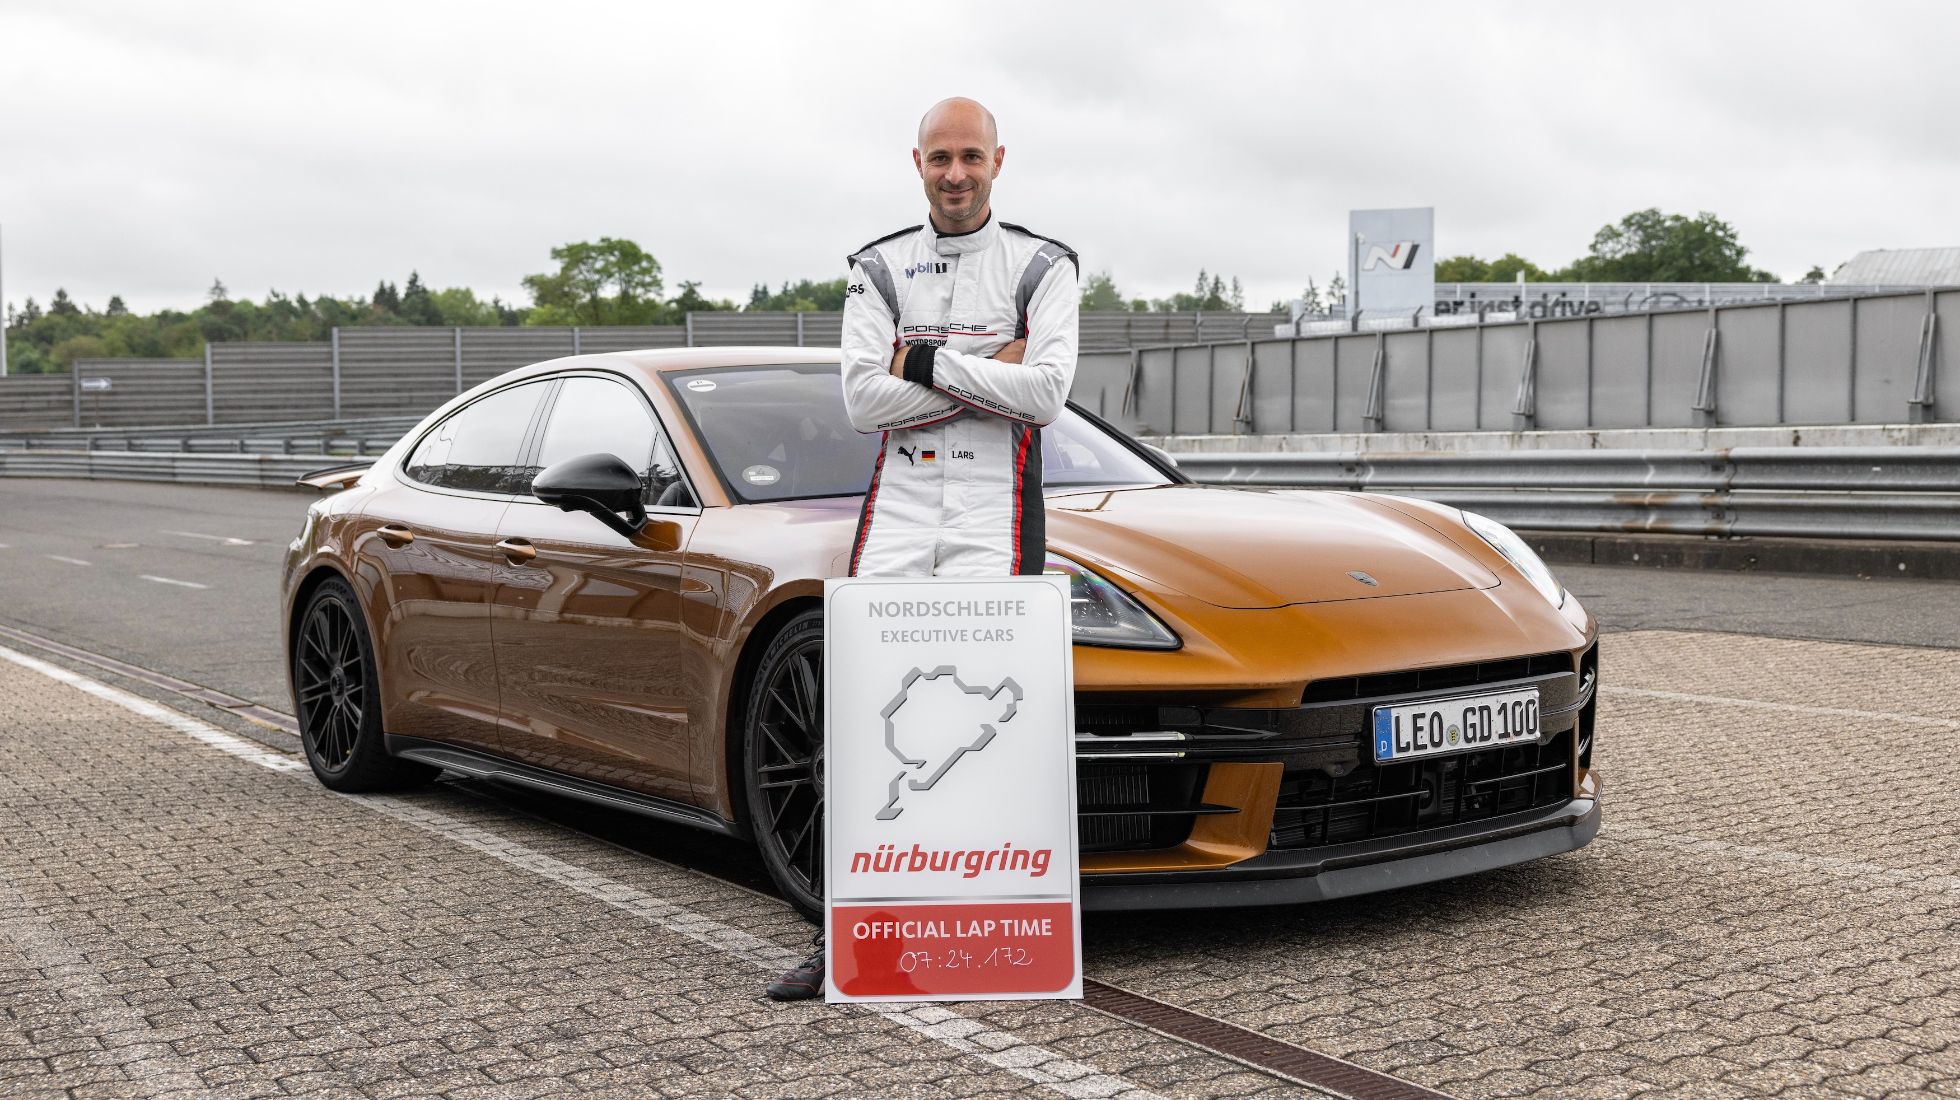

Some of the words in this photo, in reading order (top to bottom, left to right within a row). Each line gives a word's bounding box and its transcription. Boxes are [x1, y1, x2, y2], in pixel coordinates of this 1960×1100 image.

[905, 262, 933, 279] Mbil
[1529, 292, 1601, 318] drive
[903, 323, 988, 334] PORSCHE
[947, 385, 1036, 423] PORSCHE
[951, 450, 975, 460] LARS
[868, 600, 1026, 618] NORDSCHLEIFE
[881, 629, 969, 643] EXECUTIVE
[972, 628, 1015, 642] CARS
[1395, 711, 1443, 753] LEO
[1462, 704, 1492, 744] GD
[1497, 698, 1537, 739] 100
[1381, 740, 1388, 752] D
[850, 842, 1052, 879] nürburgring
[852, 920, 951, 940] OFFICIAL
[956, 919, 996, 938] LAP
[1000, 918, 1053, 937] TIME
[900, 947, 1033, 973] 07:24.172
